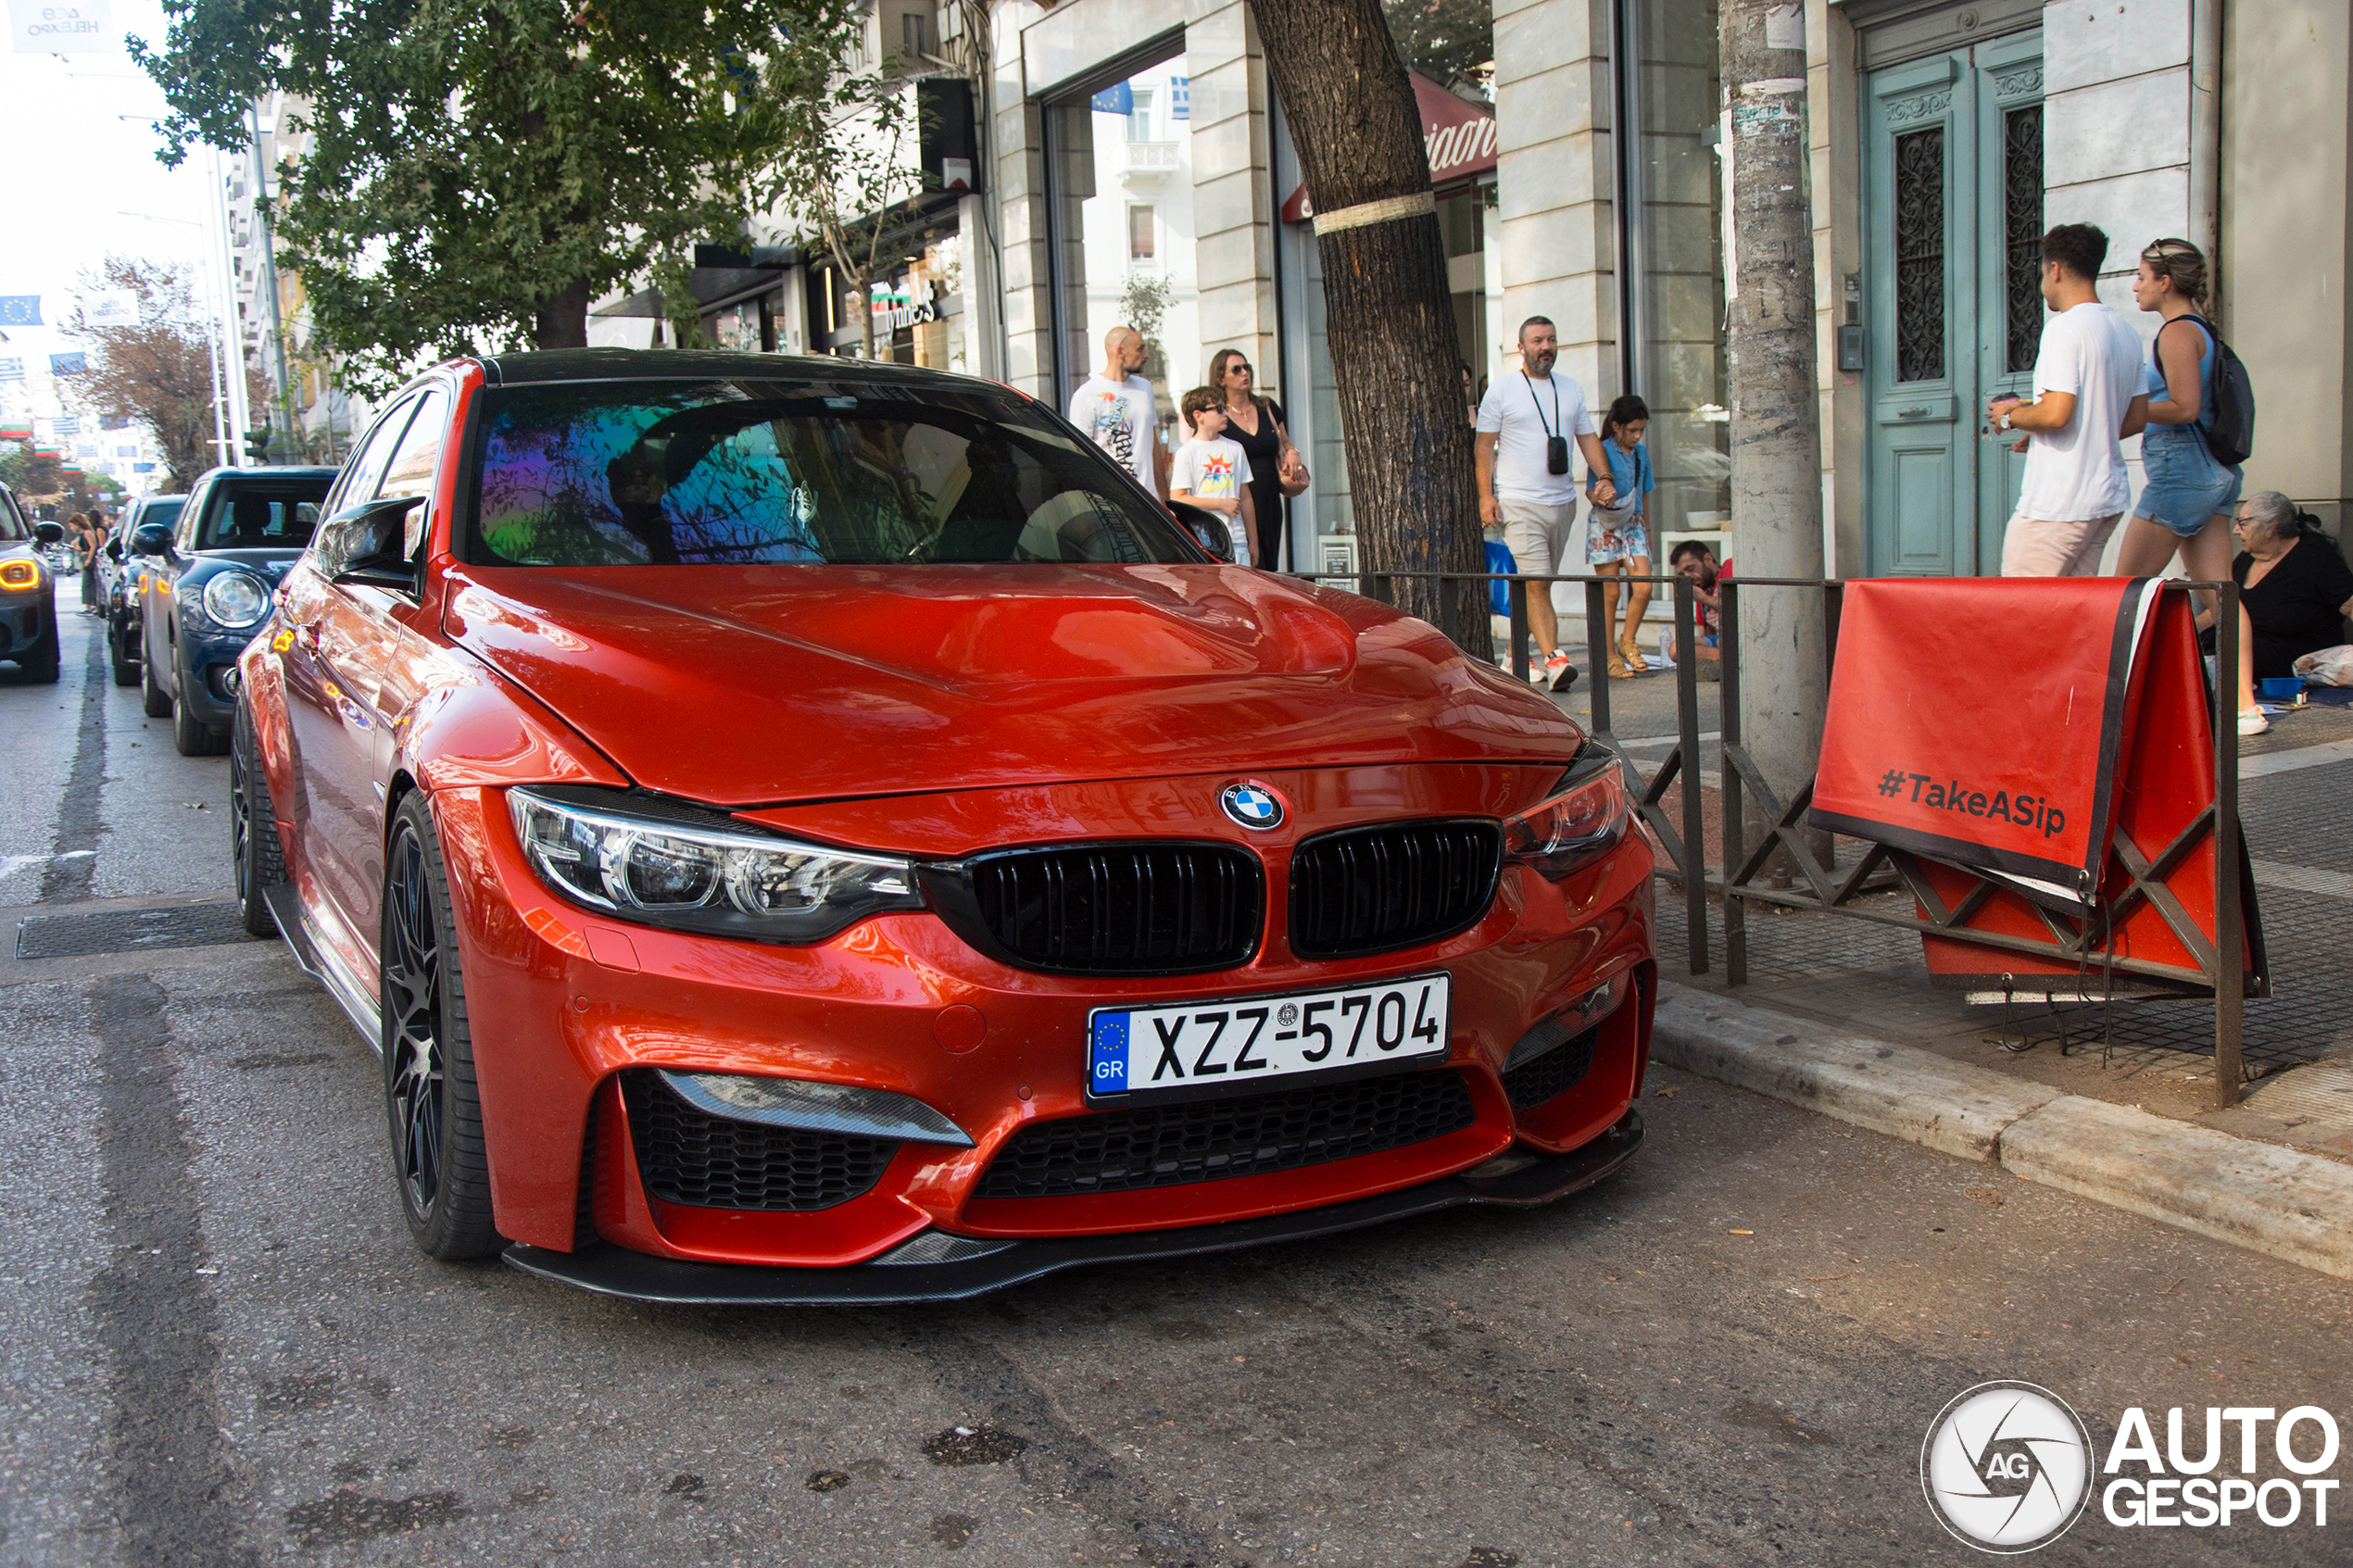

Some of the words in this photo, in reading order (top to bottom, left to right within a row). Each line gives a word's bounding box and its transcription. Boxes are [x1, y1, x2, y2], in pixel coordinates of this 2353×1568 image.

[1225, 784, 1270, 799] BMW
[1877, 768, 2066, 838] #TakeASip
[1151, 985, 1439, 1082] XZZ-5704
[1096, 1060, 1124, 1079] GR
